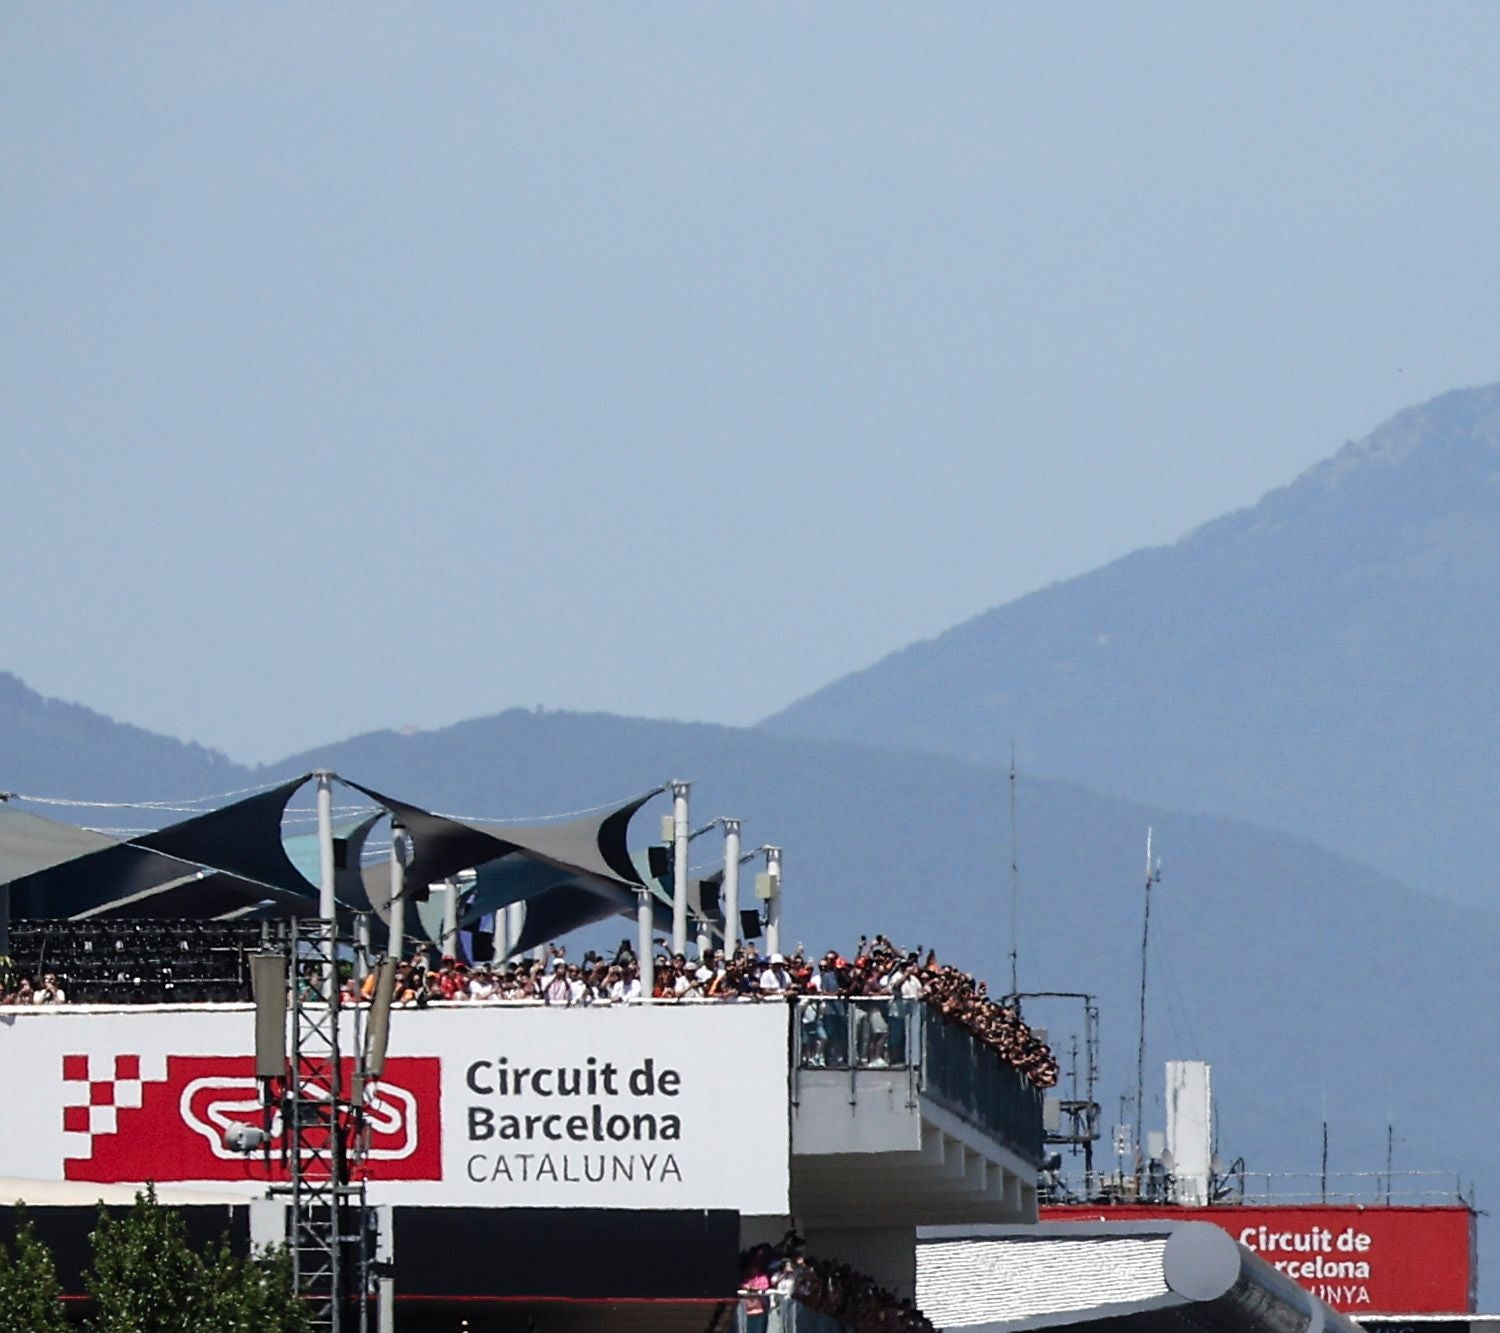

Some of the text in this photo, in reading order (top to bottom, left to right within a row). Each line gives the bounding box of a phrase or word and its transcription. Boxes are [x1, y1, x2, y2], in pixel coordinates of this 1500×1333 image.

[466, 1056, 682, 1096] Circuit de
[467, 1103, 682, 1142] Barcelona
[466, 1153, 684, 1184] CATALUNYA
[1239, 1226, 1372, 1252] Circuit de
[1275, 1256, 1371, 1279] rcelona
